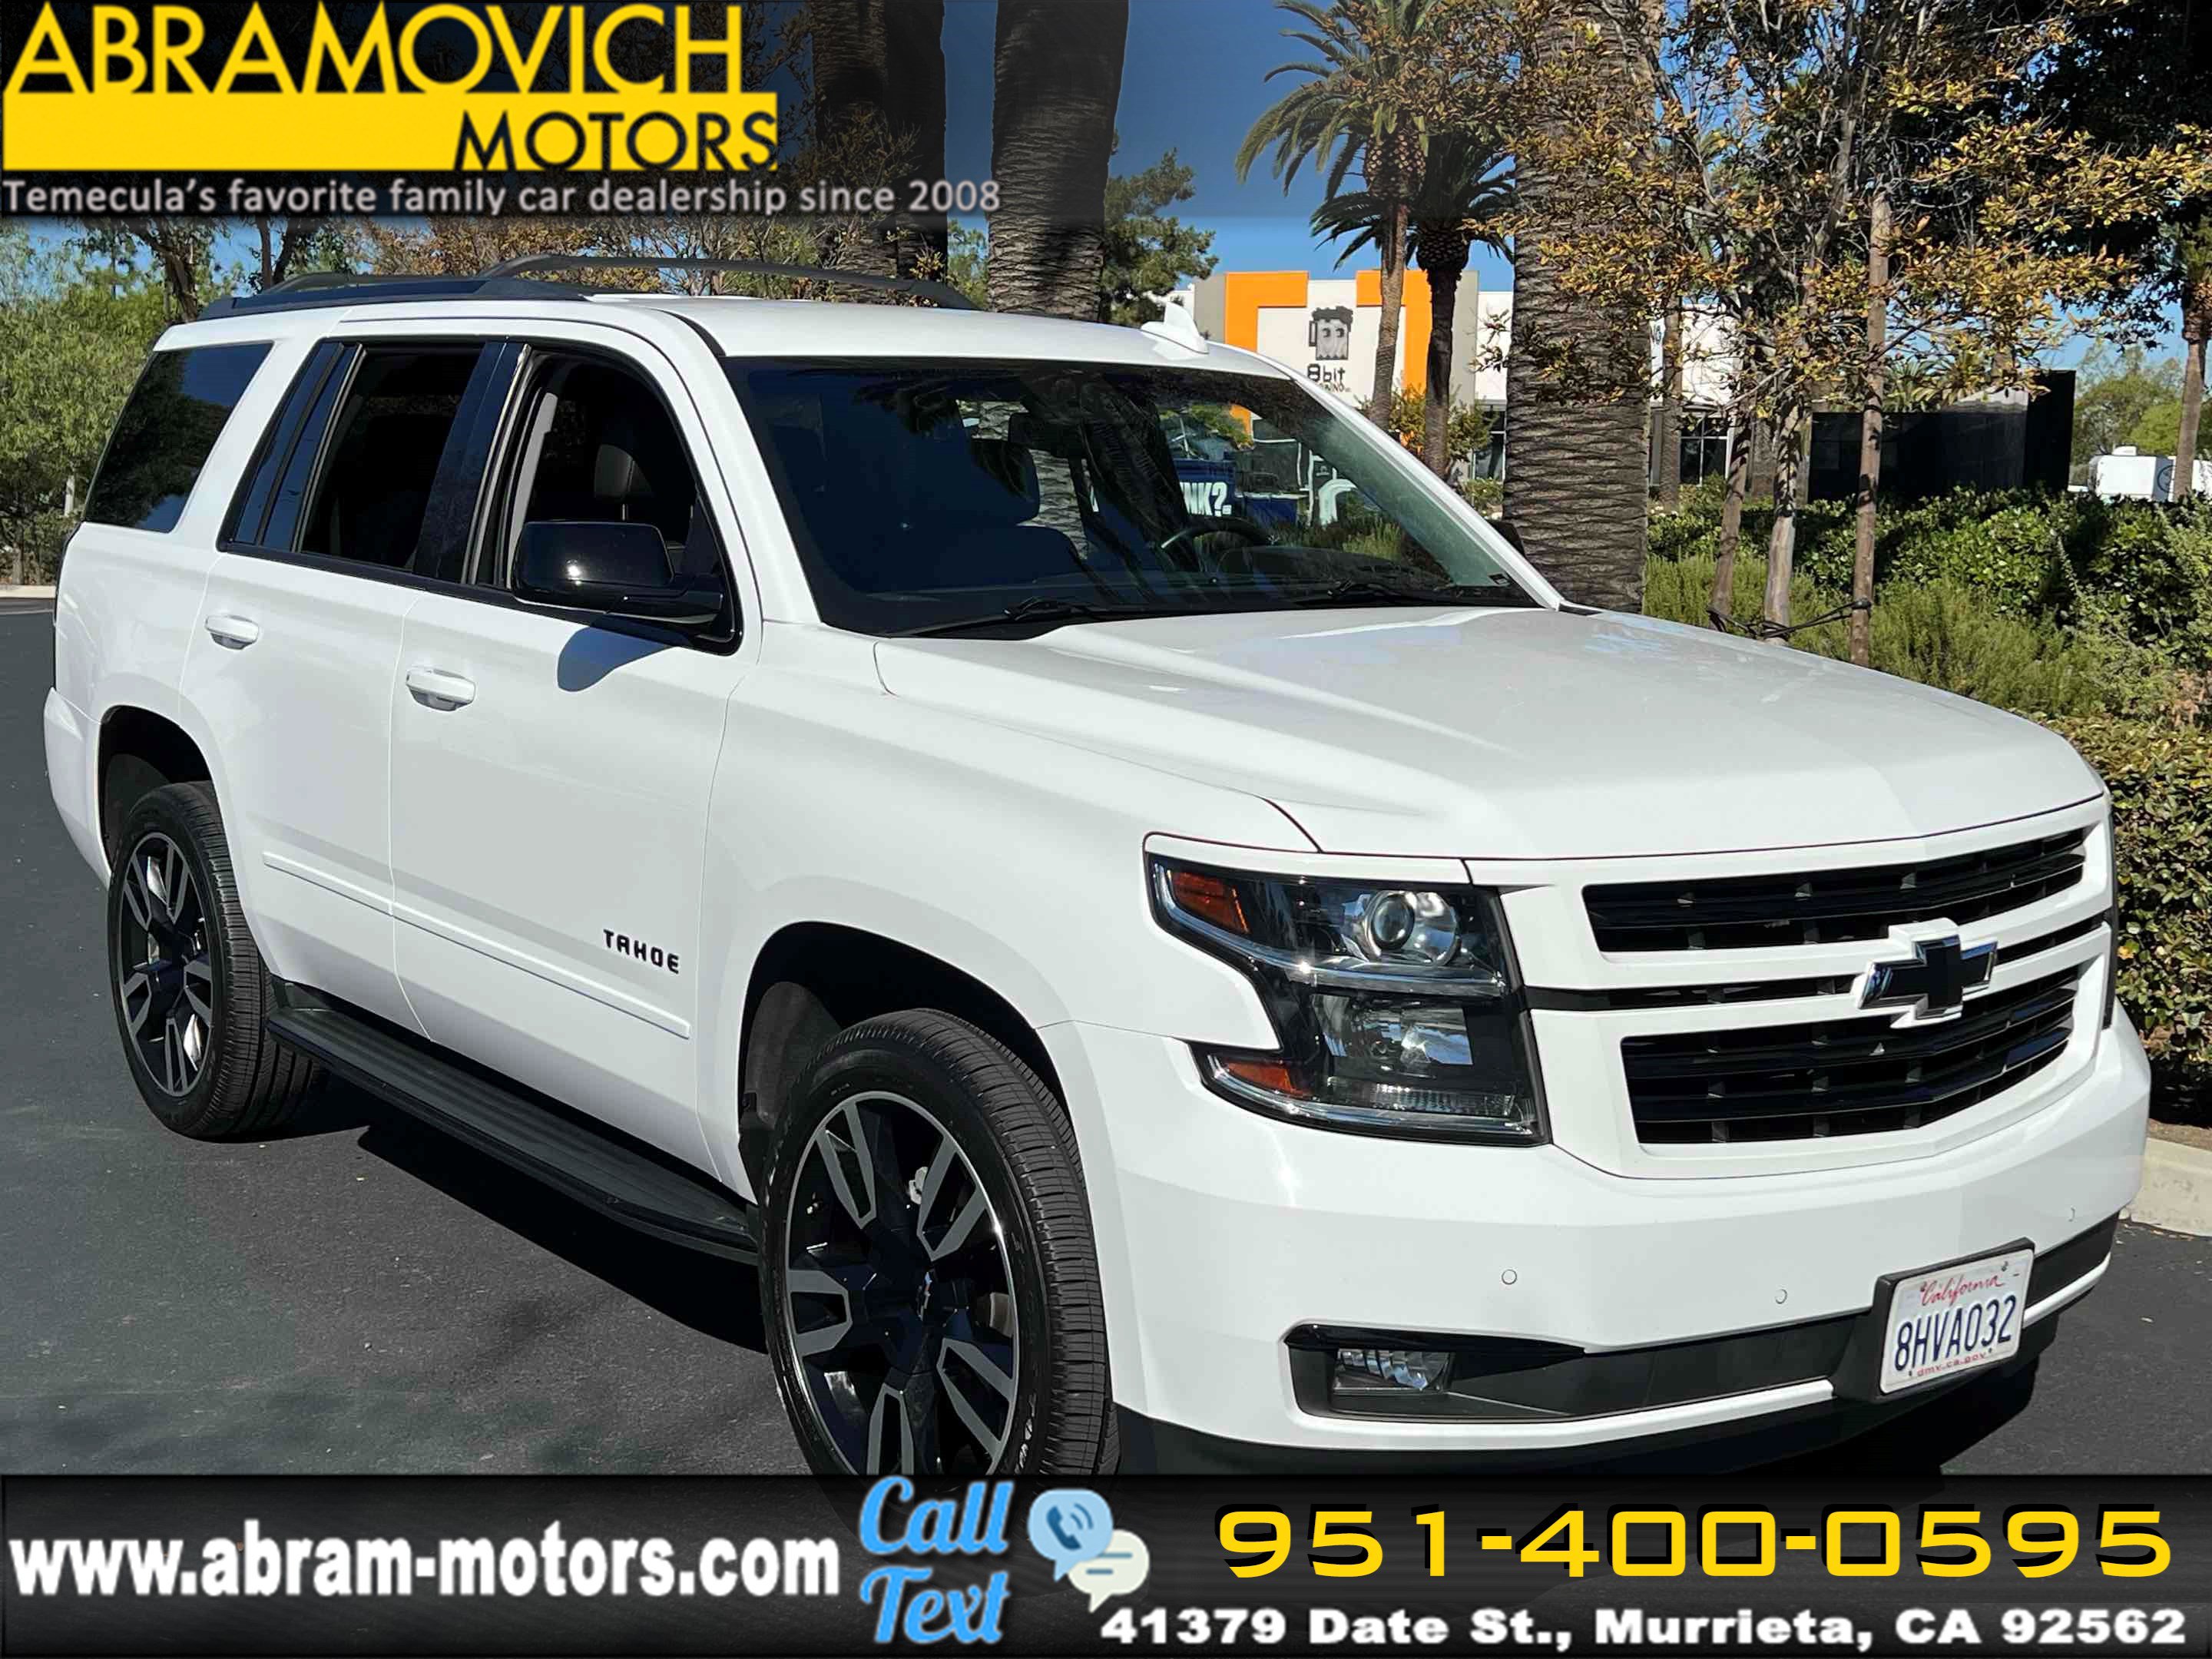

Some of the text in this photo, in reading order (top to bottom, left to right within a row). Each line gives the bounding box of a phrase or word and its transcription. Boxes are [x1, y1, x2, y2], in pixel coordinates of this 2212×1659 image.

[1307, 363, 1346, 383] 8bit
[603, 929, 680, 975] TAHOE
[1919, 1273, 2005, 1307] California
[1894, 1294, 2016, 1372] 8HVA032
